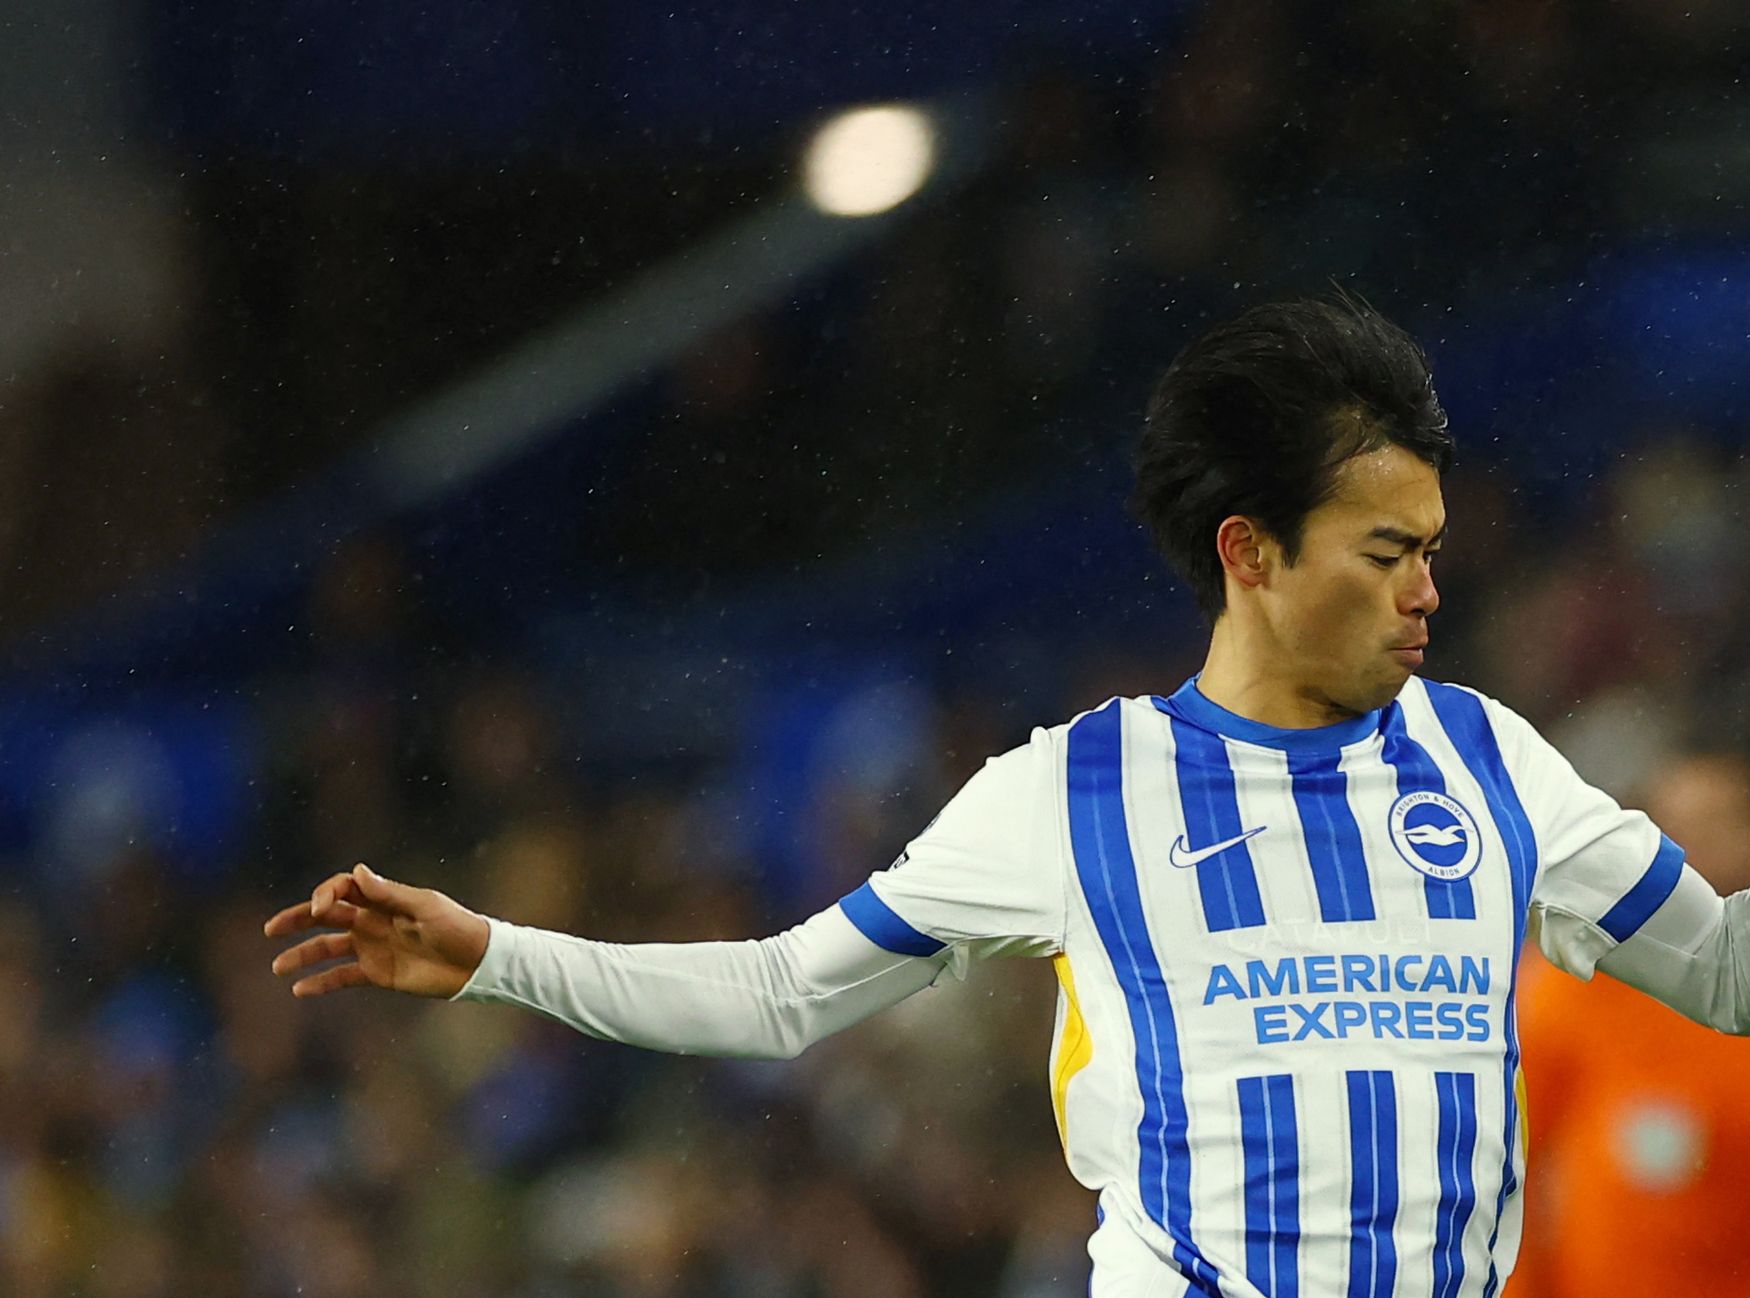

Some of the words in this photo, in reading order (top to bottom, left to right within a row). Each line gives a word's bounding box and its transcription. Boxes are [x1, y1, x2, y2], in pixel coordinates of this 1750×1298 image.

[1395, 793, 1430, 818] BRIGHTON
[1442, 800, 1464, 818] HOVE
[1427, 866, 1460, 877] ALBION
[1202, 953, 1491, 1006] AMERICAN
[1252, 1000, 1491, 1045] EXPRESS
